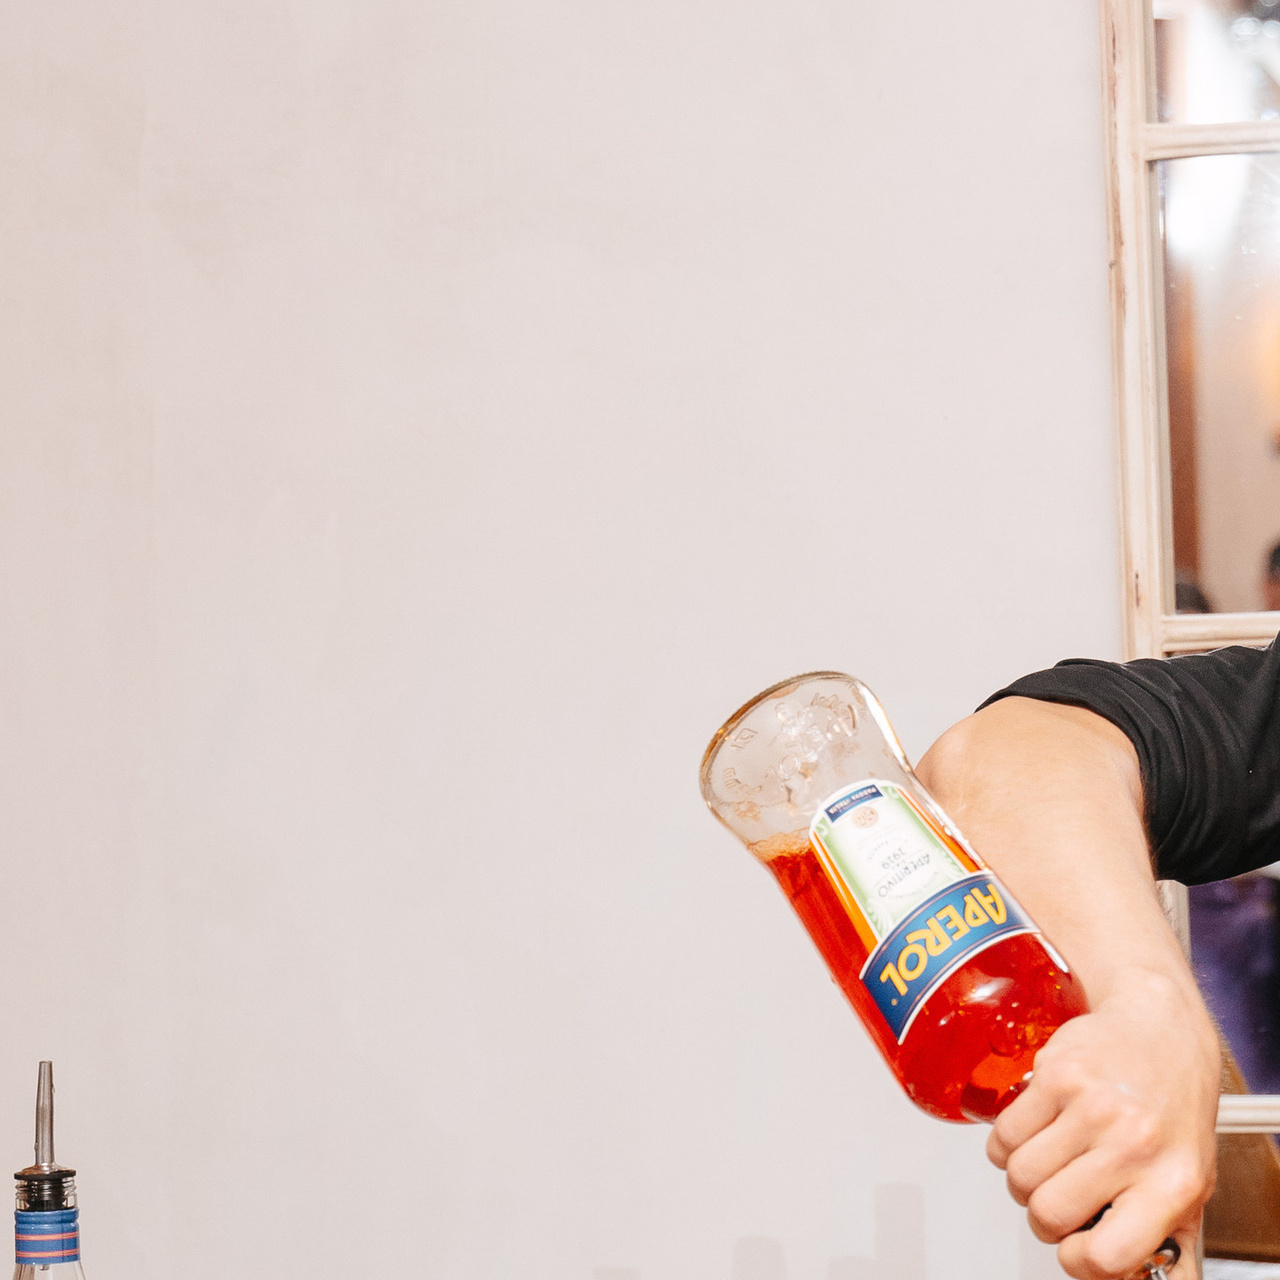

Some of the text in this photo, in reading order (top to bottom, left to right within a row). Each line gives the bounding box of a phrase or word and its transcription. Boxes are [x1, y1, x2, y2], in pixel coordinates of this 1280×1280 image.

[878, 854, 930, 898] APERITIVO
[882, 848, 906, 869] 1919
[880, 884, 1007, 996] APEROL
